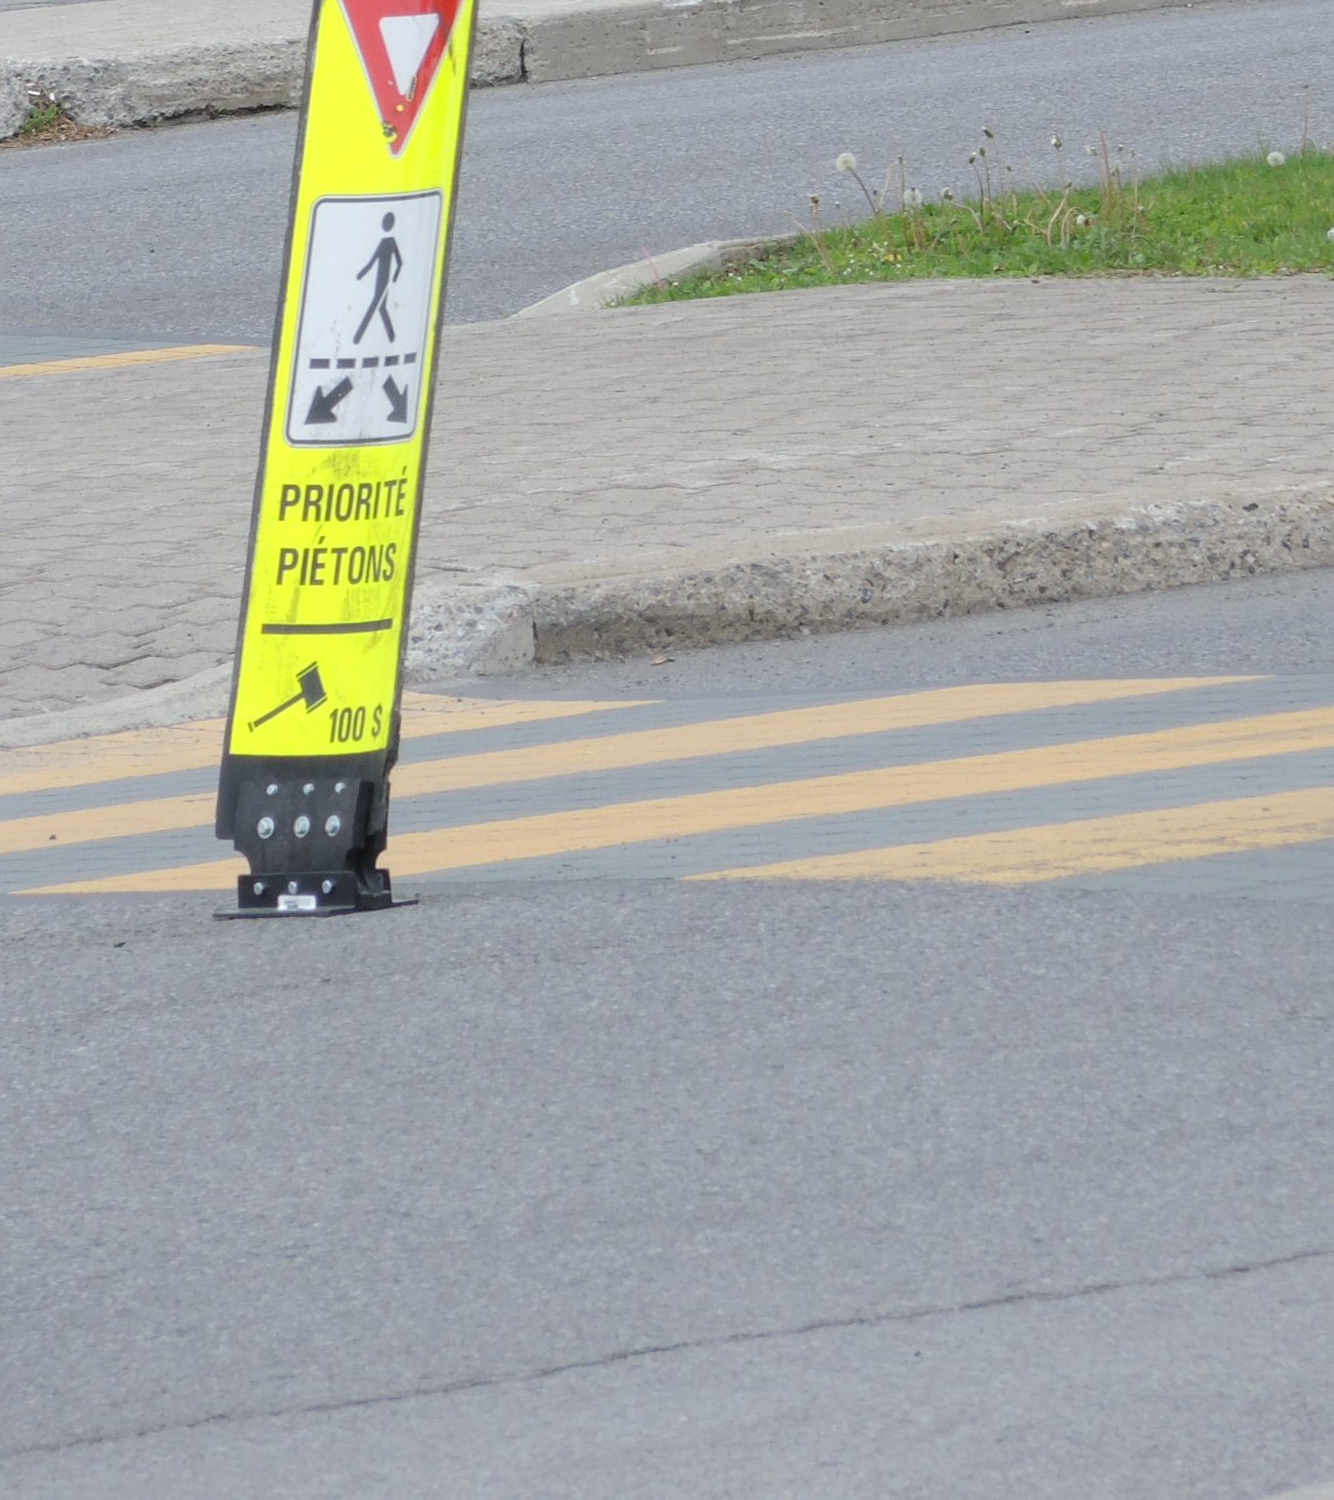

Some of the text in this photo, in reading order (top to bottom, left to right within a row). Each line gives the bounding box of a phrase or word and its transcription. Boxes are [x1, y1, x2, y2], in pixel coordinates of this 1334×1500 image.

[277, 466, 408, 523] PRIORITÉ
[275, 536, 398, 586] PIÉTONS
[329, 704, 383, 744] 100 $
